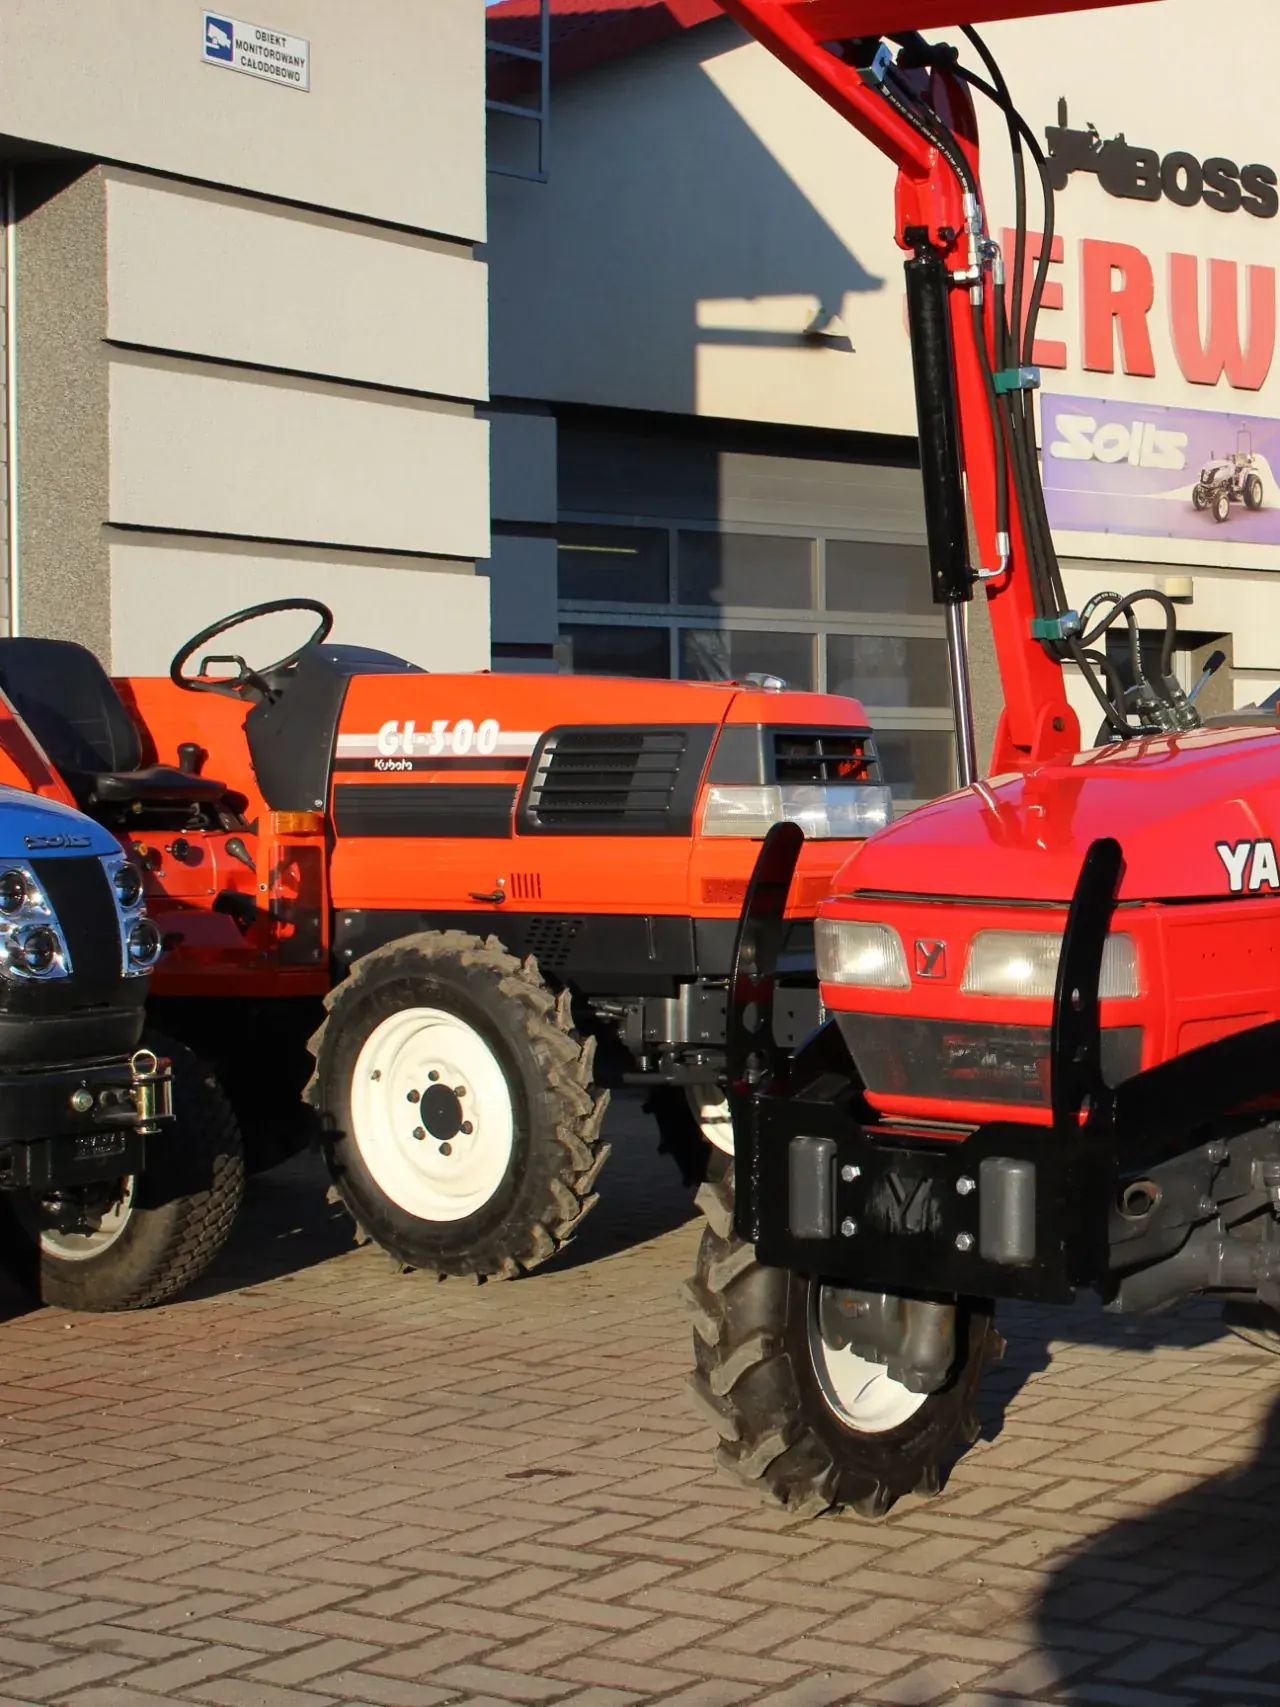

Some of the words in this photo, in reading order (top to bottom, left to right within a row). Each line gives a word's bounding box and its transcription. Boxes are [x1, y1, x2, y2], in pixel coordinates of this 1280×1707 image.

[255, 30, 287, 47] OBIEKT
[235, 39, 306, 68] MONITOROWANY
[240, 56, 301, 82] CAŁODOBOWO
[1118, 145, 1279, 219] BOSS
[374, 759, 413, 771] Kubota
